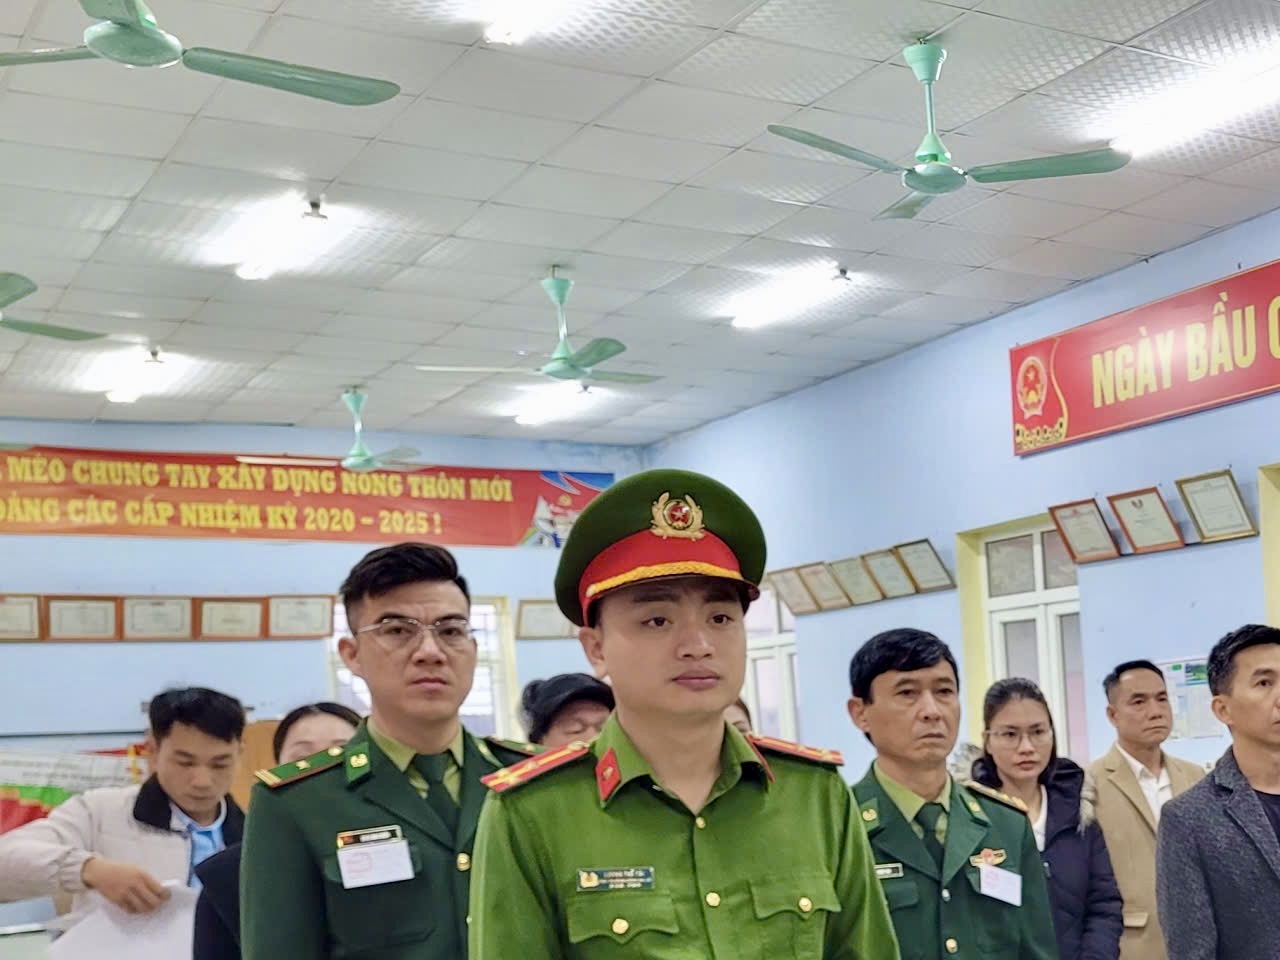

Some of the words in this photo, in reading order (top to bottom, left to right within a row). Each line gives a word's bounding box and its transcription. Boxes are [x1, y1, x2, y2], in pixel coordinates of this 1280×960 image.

[1091, 326, 1175, 409] NGÀY
[1184, 291, 1257, 382] BẦU
[71, 459, 160, 487] CHUNG
[164, 462, 212, 489] TAY
[216, 462, 267, 491] XÂY
[407, 471, 466, 500] THÔN
[469, 474, 514, 502] MỚI
[66, 494, 118, 525] CÁC
[124, 493, 176, 527] CẤP
[180, 498, 263, 534] NHIỆM
[303, 506, 356, 533] 2020
[378, 510, 430, 535] 2025
